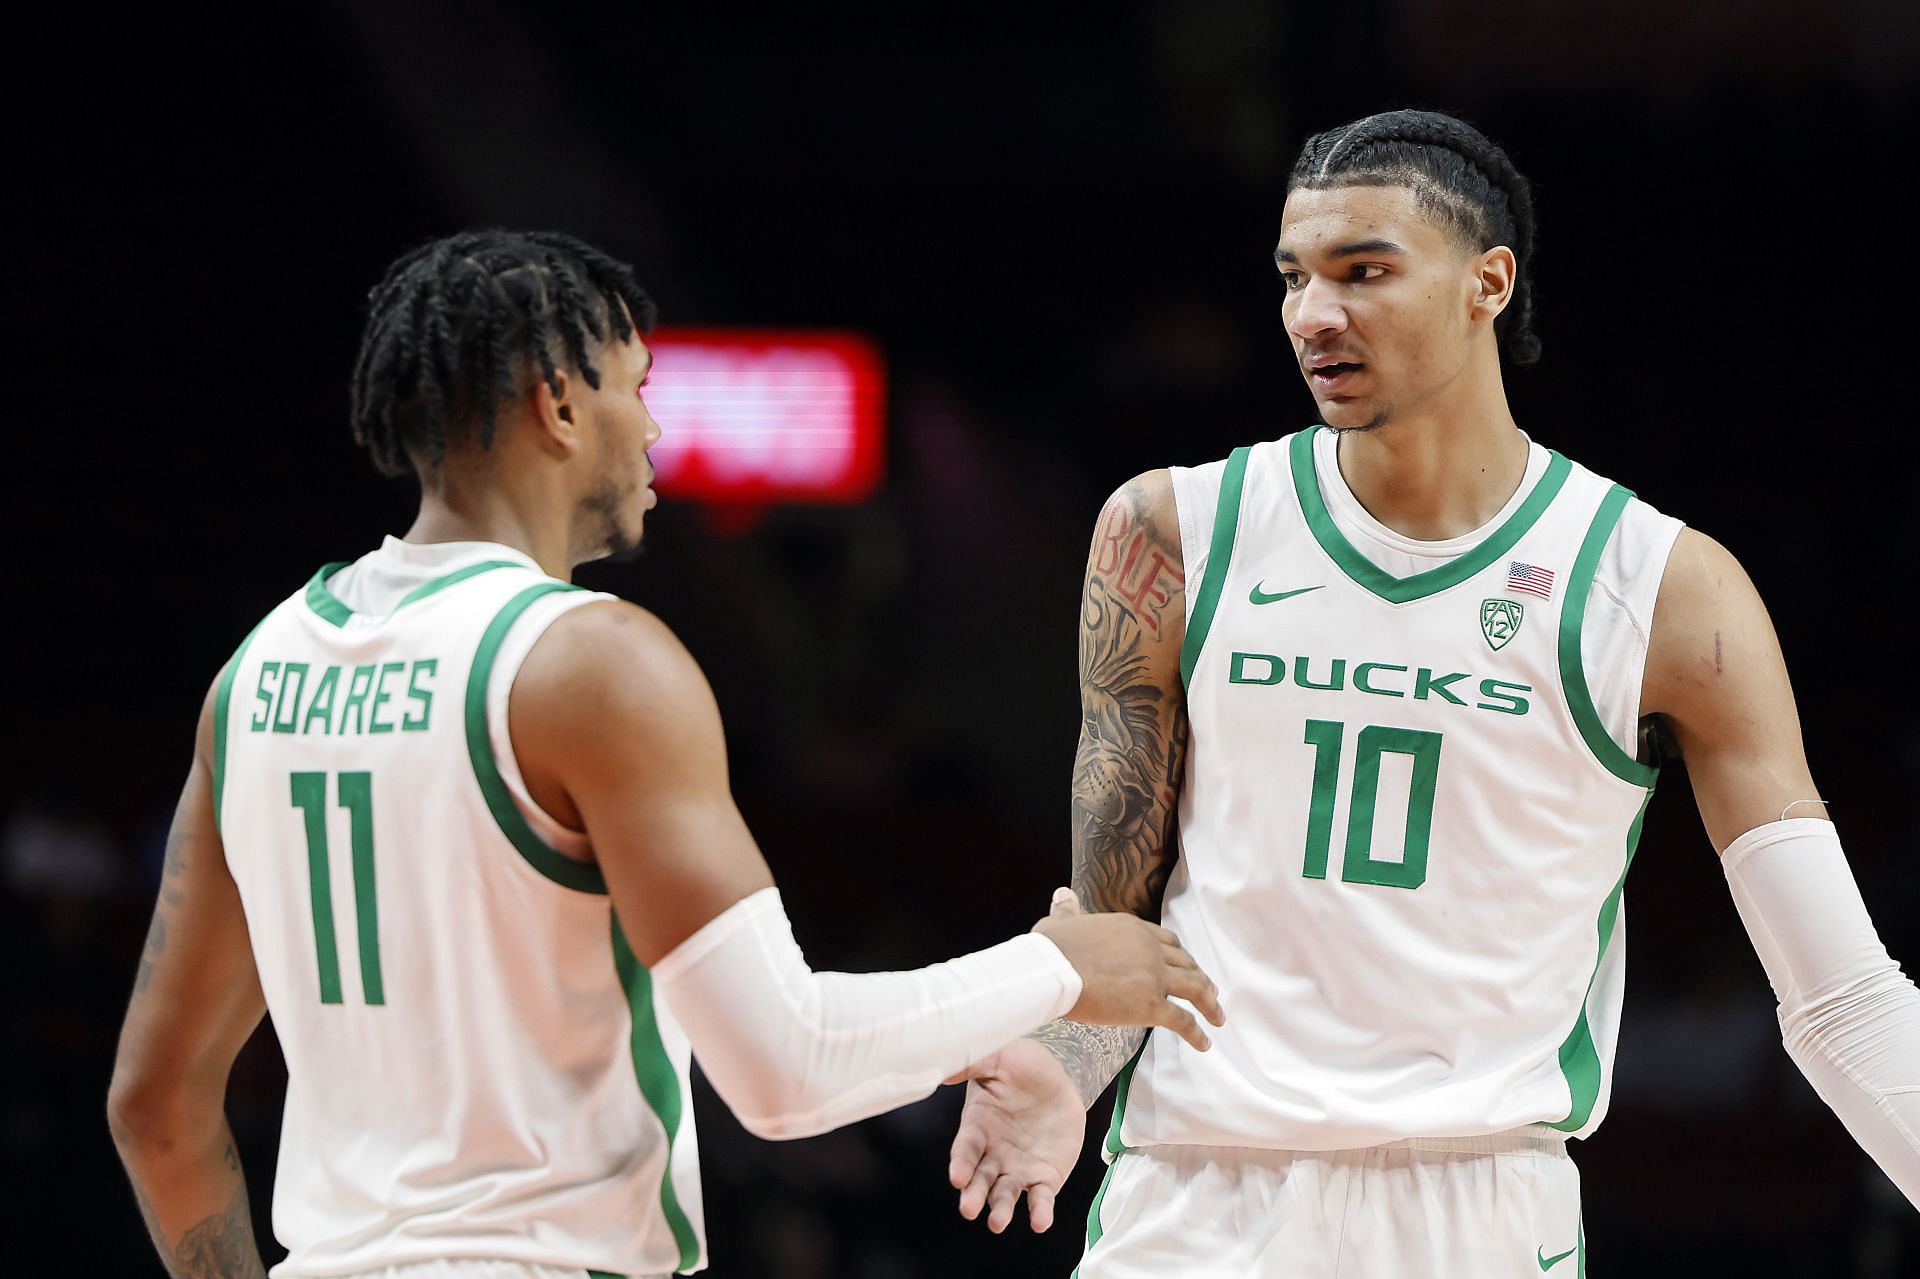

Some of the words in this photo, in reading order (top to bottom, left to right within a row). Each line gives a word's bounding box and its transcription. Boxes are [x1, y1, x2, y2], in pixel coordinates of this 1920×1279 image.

[1484, 602, 1521, 631] PAC
[1489, 620, 1509, 639] 12
[251, 658, 438, 735] SOARES
[1229, 651, 1532, 715] DUCKS
[1302, 719, 1443, 889] 10
[290, 771, 385, 1004] 11
